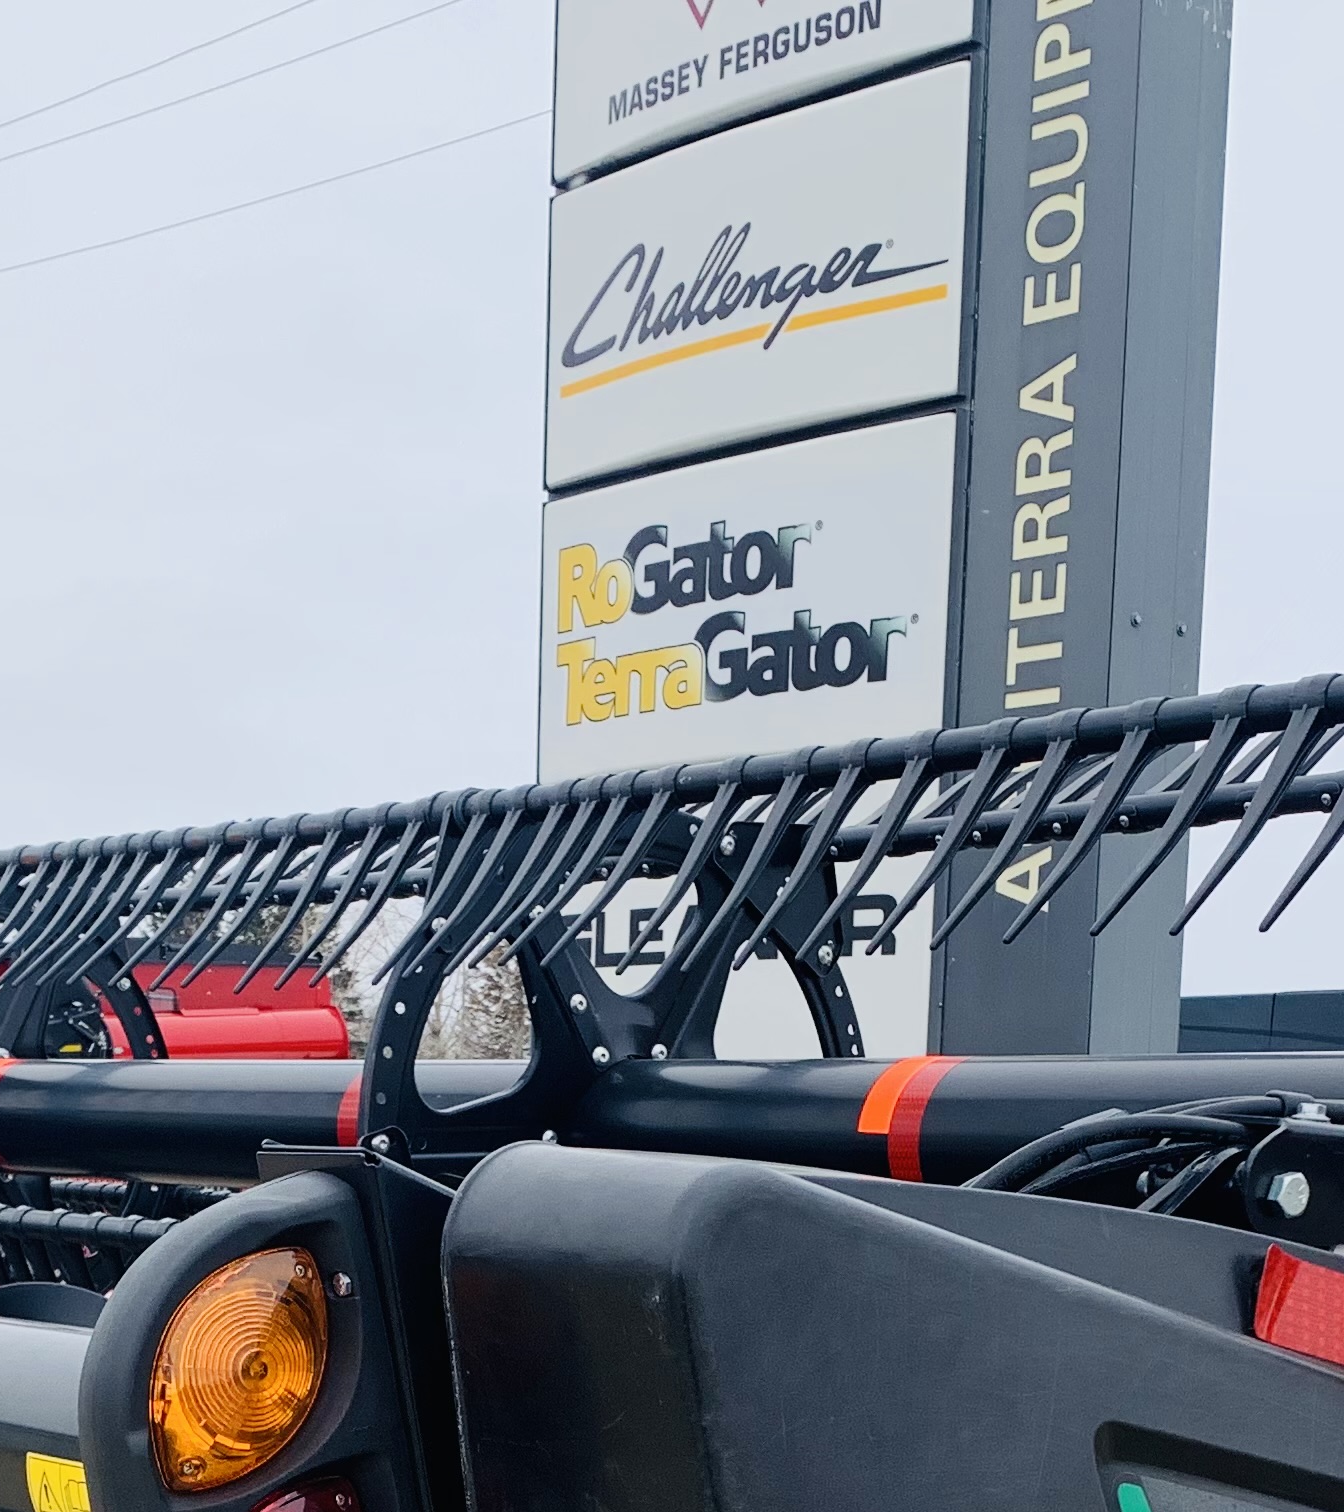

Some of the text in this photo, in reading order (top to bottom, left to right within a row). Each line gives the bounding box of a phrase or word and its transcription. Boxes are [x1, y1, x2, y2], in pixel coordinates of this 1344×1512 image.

[608, 0, 882, 125] MASSEY FERGUSON
[560, 221, 949, 369] Challenger
[556, 519, 813, 633] RoGator
[556, 609, 908, 726] TerraGator
